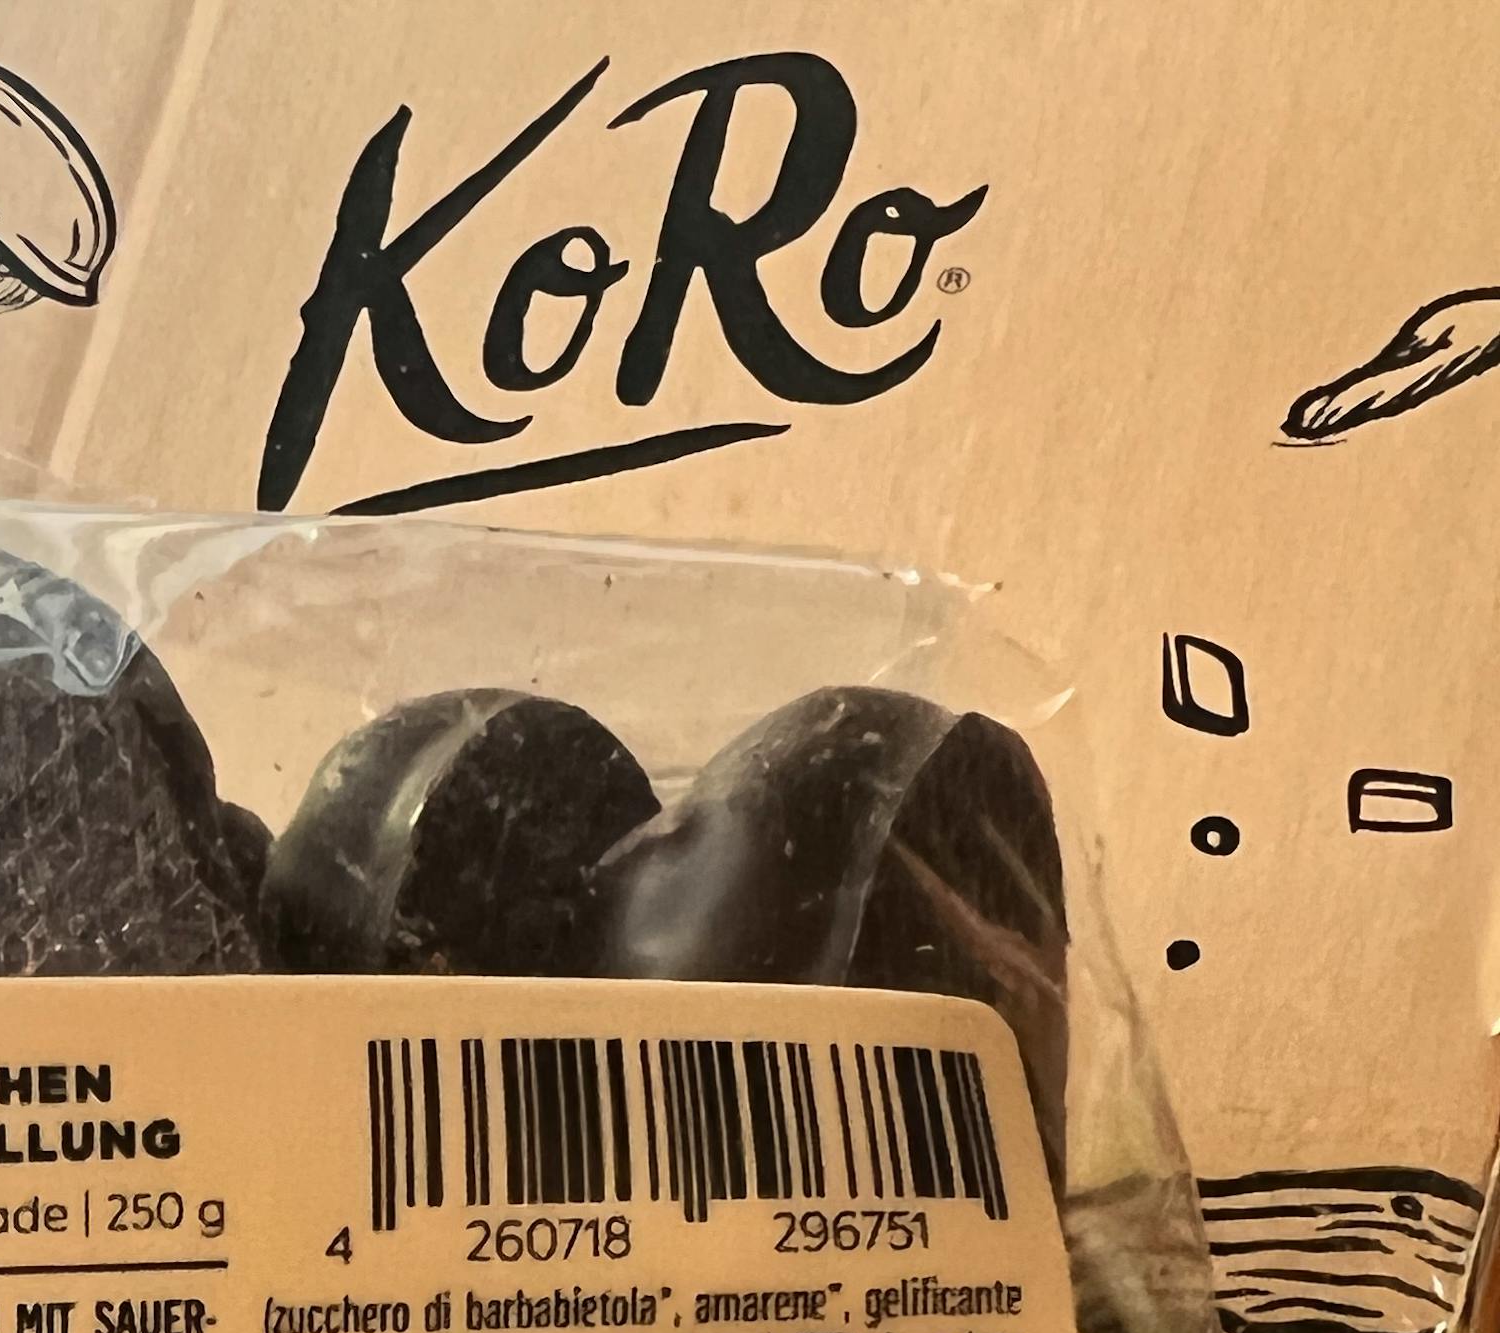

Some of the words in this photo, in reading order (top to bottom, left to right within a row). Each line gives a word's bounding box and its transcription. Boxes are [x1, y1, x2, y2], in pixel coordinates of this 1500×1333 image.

[257, 50, 989, 514] KoRo
[107, 1191, 185, 1233] 250
[197, 1199, 225, 1238] g
[324, 1225, 354, 1266] 4
[465, 1214, 632, 1263] 260718
[772, 1210, 929, 1254] 296751
